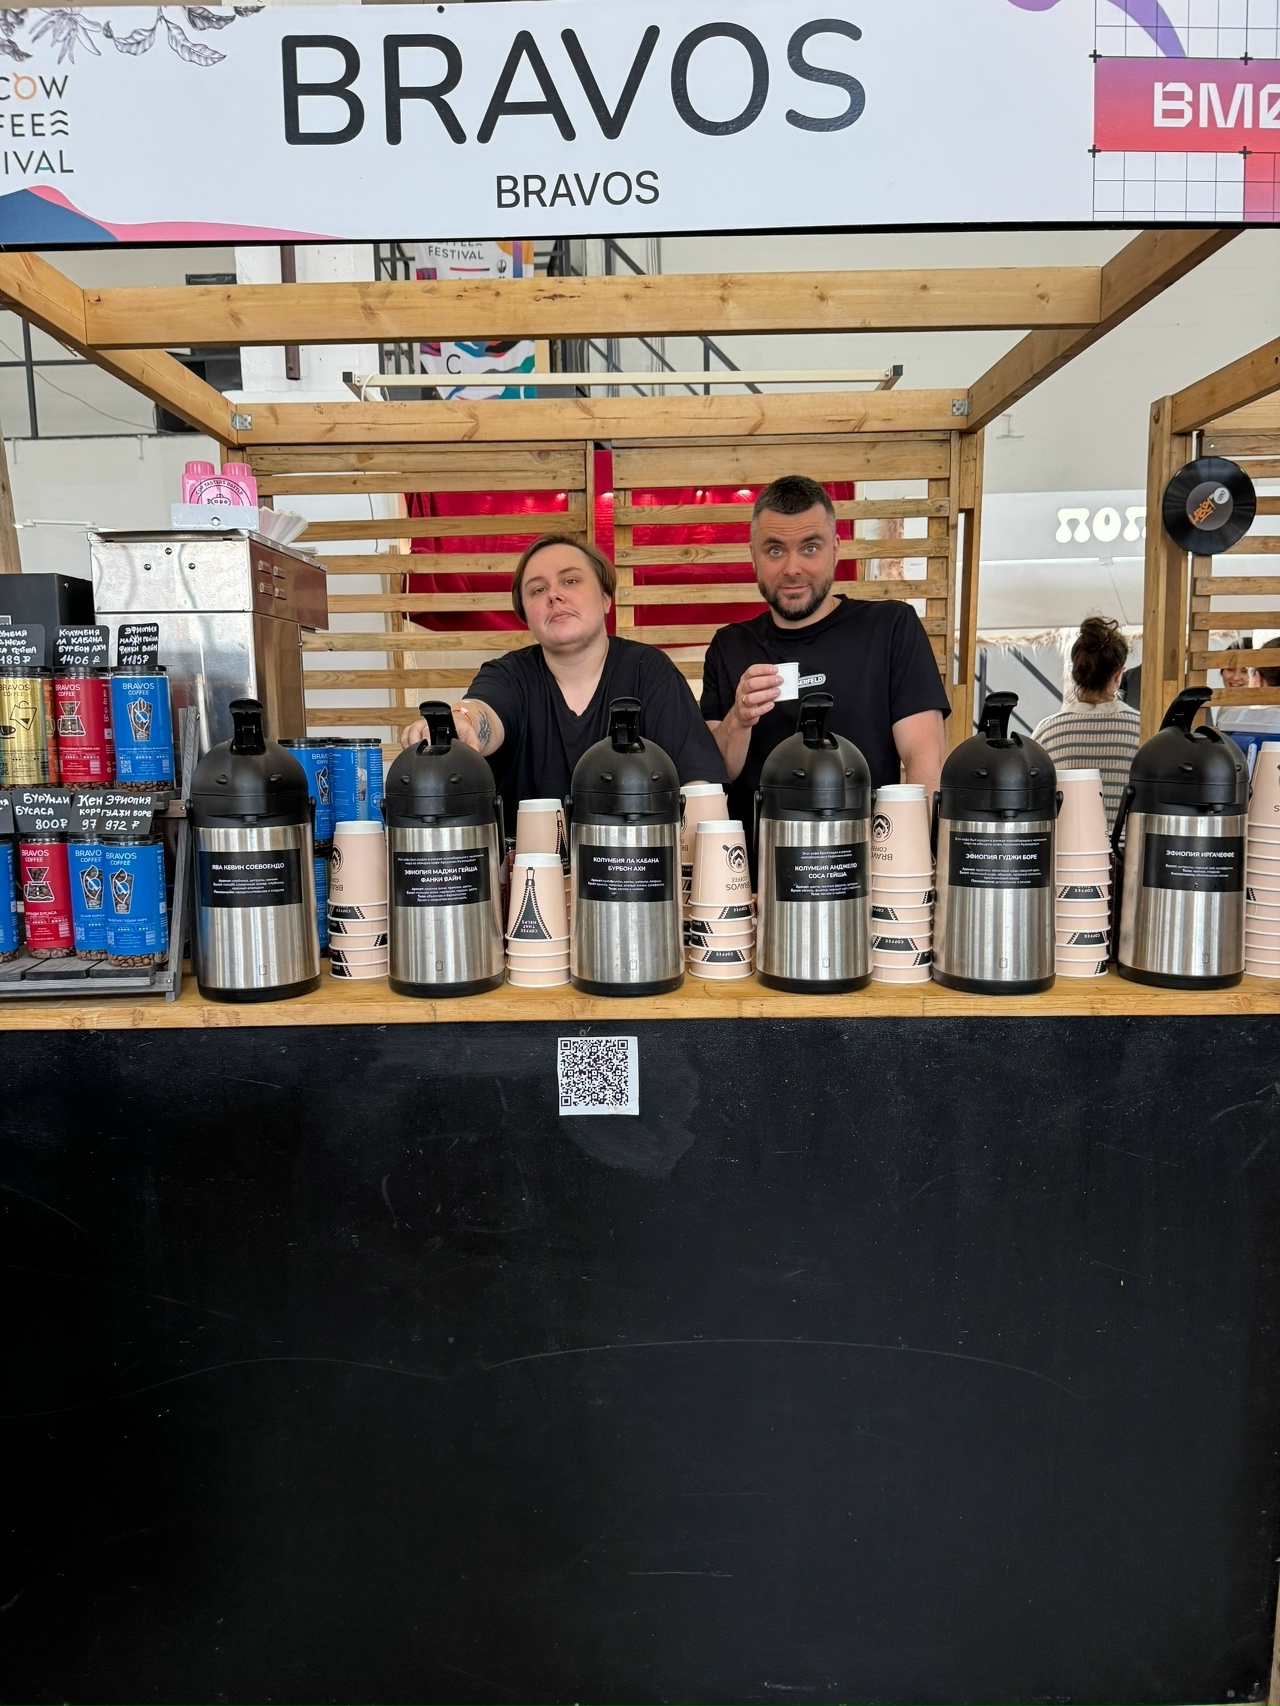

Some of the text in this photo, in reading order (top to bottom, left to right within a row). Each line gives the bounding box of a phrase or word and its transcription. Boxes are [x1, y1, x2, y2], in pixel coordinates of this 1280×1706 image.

[281, 18, 867, 146] BRAVOS
[496, 170, 660, 208] BRAVOS
[428, 245, 484, 260] FESTIVAL
[71, 636, 103, 644] КАБАНА
[58, 644, 107, 653] БУРБОН АХИ
[60, 654, 89, 665] 1406
[55, 683, 81, 691] BRAVOS
[122, 682, 155, 690] BRAVOS
[105, 820, 128, 831] 972
[21, 849, 50, 857] BRAVOS
[106, 852, 137, 860] BRAVOS
[1165, 849, 1200, 857] ЭФИОПИЯ
[829, 862, 857, 870] АНДЖЕЛО
[444, 875, 462, 883] ВАЙН
